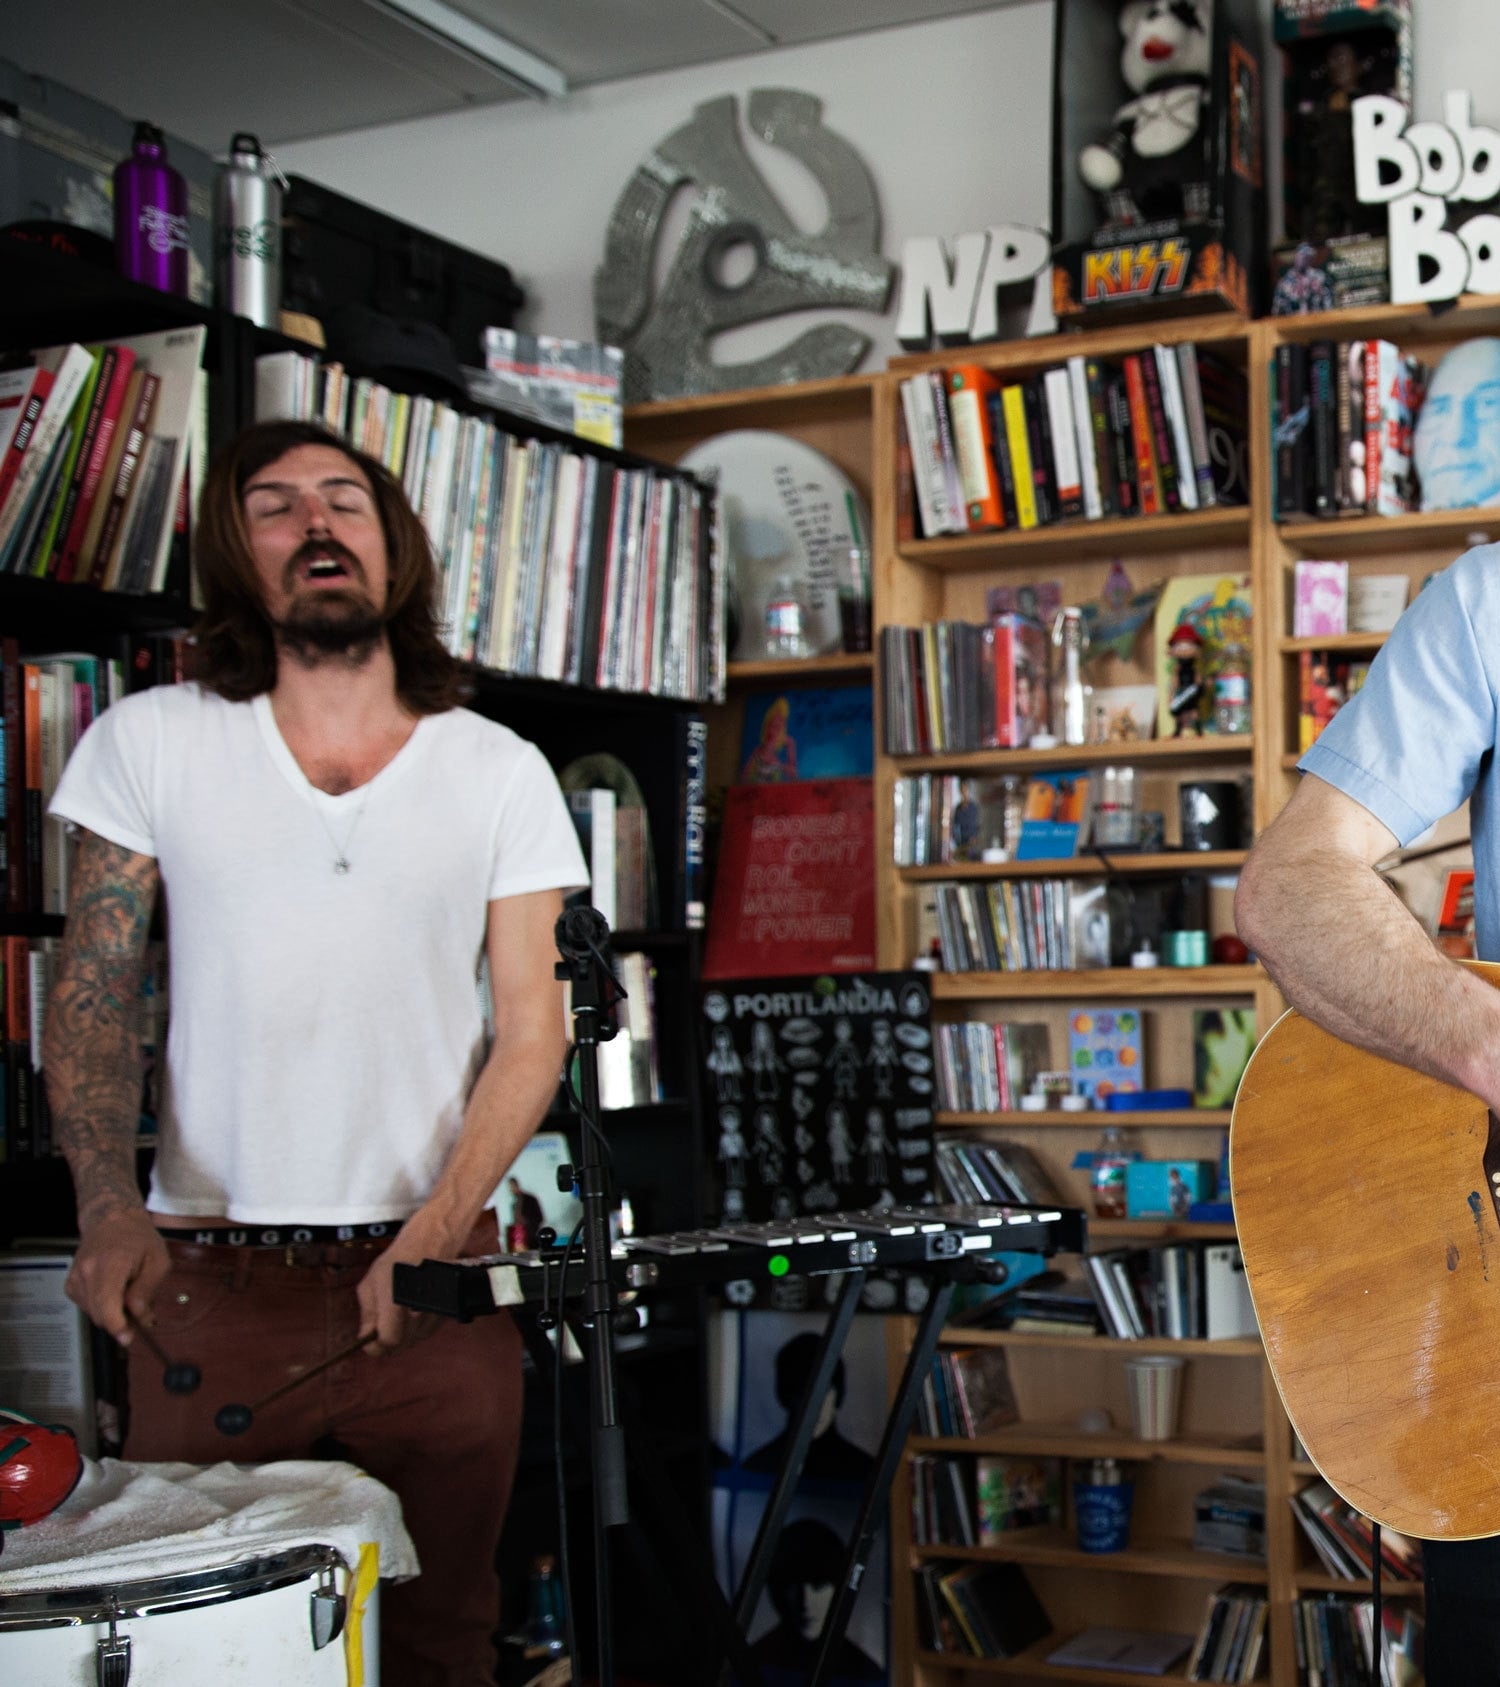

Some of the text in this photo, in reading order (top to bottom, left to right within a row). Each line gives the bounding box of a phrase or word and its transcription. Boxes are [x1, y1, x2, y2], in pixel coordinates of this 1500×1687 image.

[1082, 234, 1191, 307] KISS
[733, 988, 897, 1021] PORTLANDIA
[195, 1222, 388, 1246] HUGO BO
